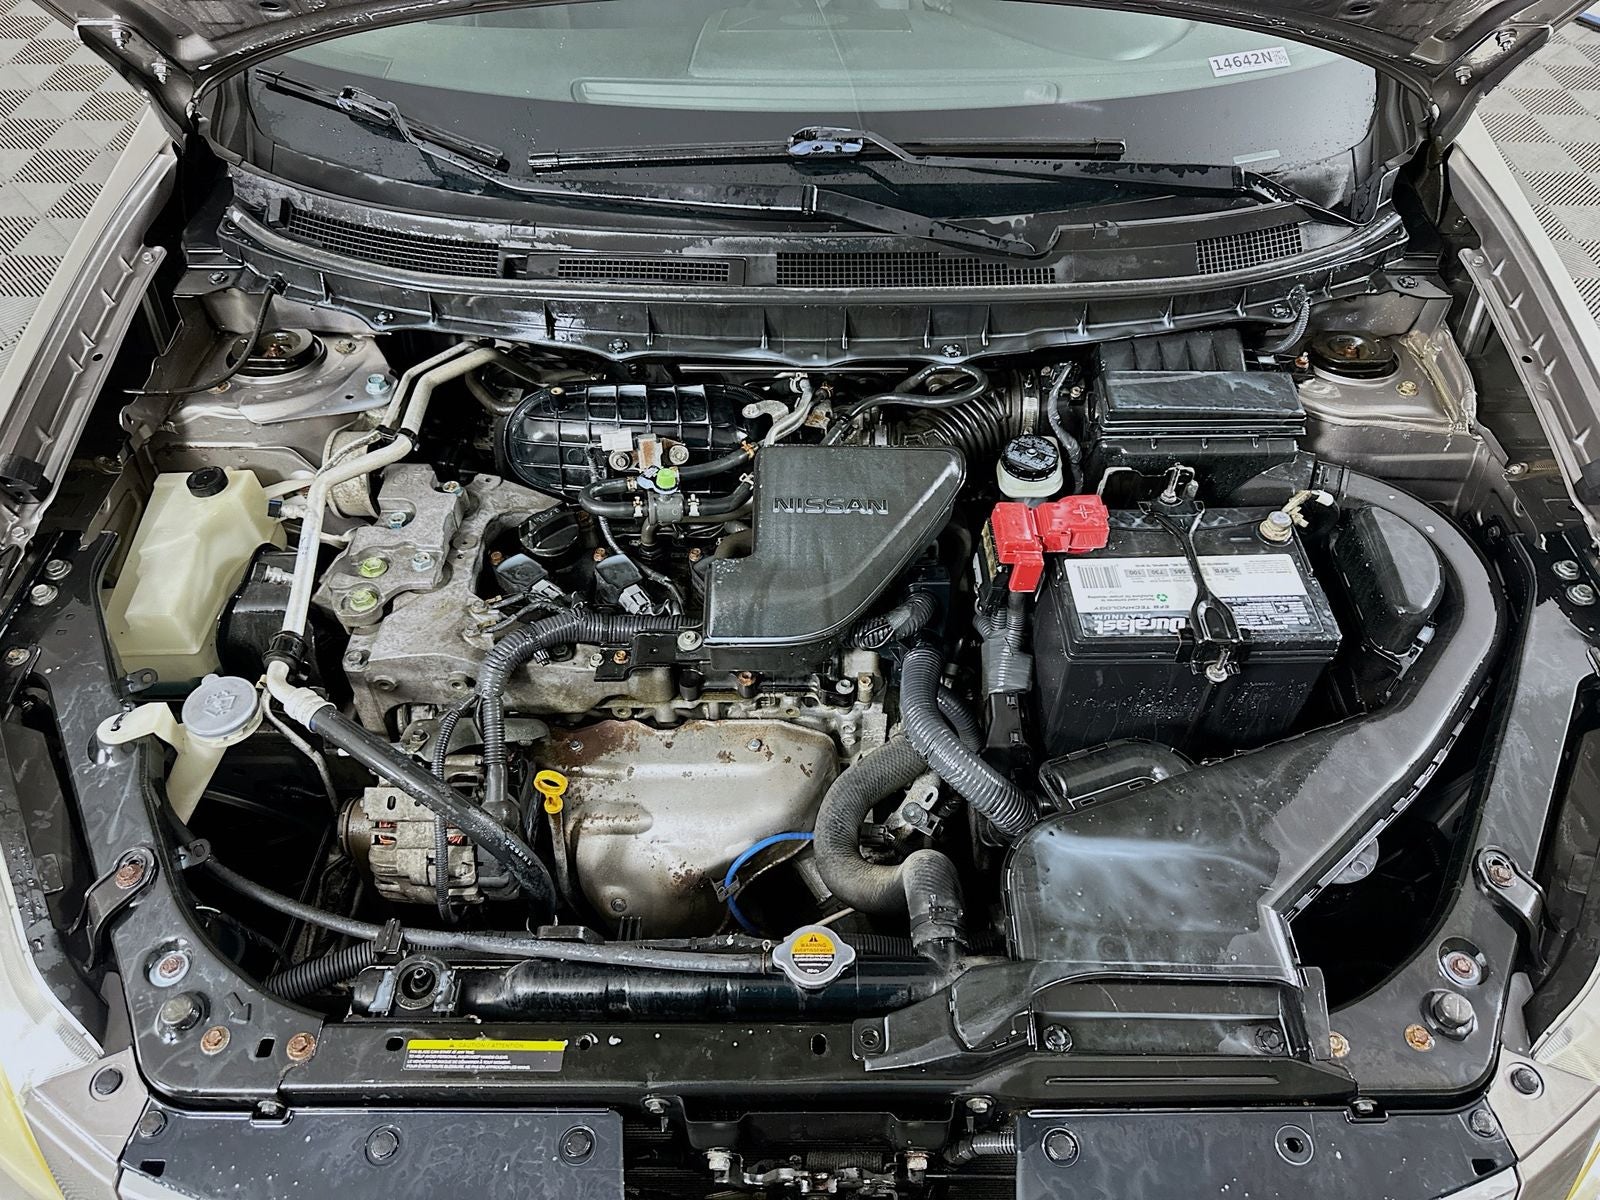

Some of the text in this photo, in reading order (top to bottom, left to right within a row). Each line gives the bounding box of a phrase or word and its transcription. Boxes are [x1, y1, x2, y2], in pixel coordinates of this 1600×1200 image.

[1213, 51, 1273, 71] 14642N
[772, 497, 889, 514] NISSAN
[1094, 617, 1186, 635] Duralast
